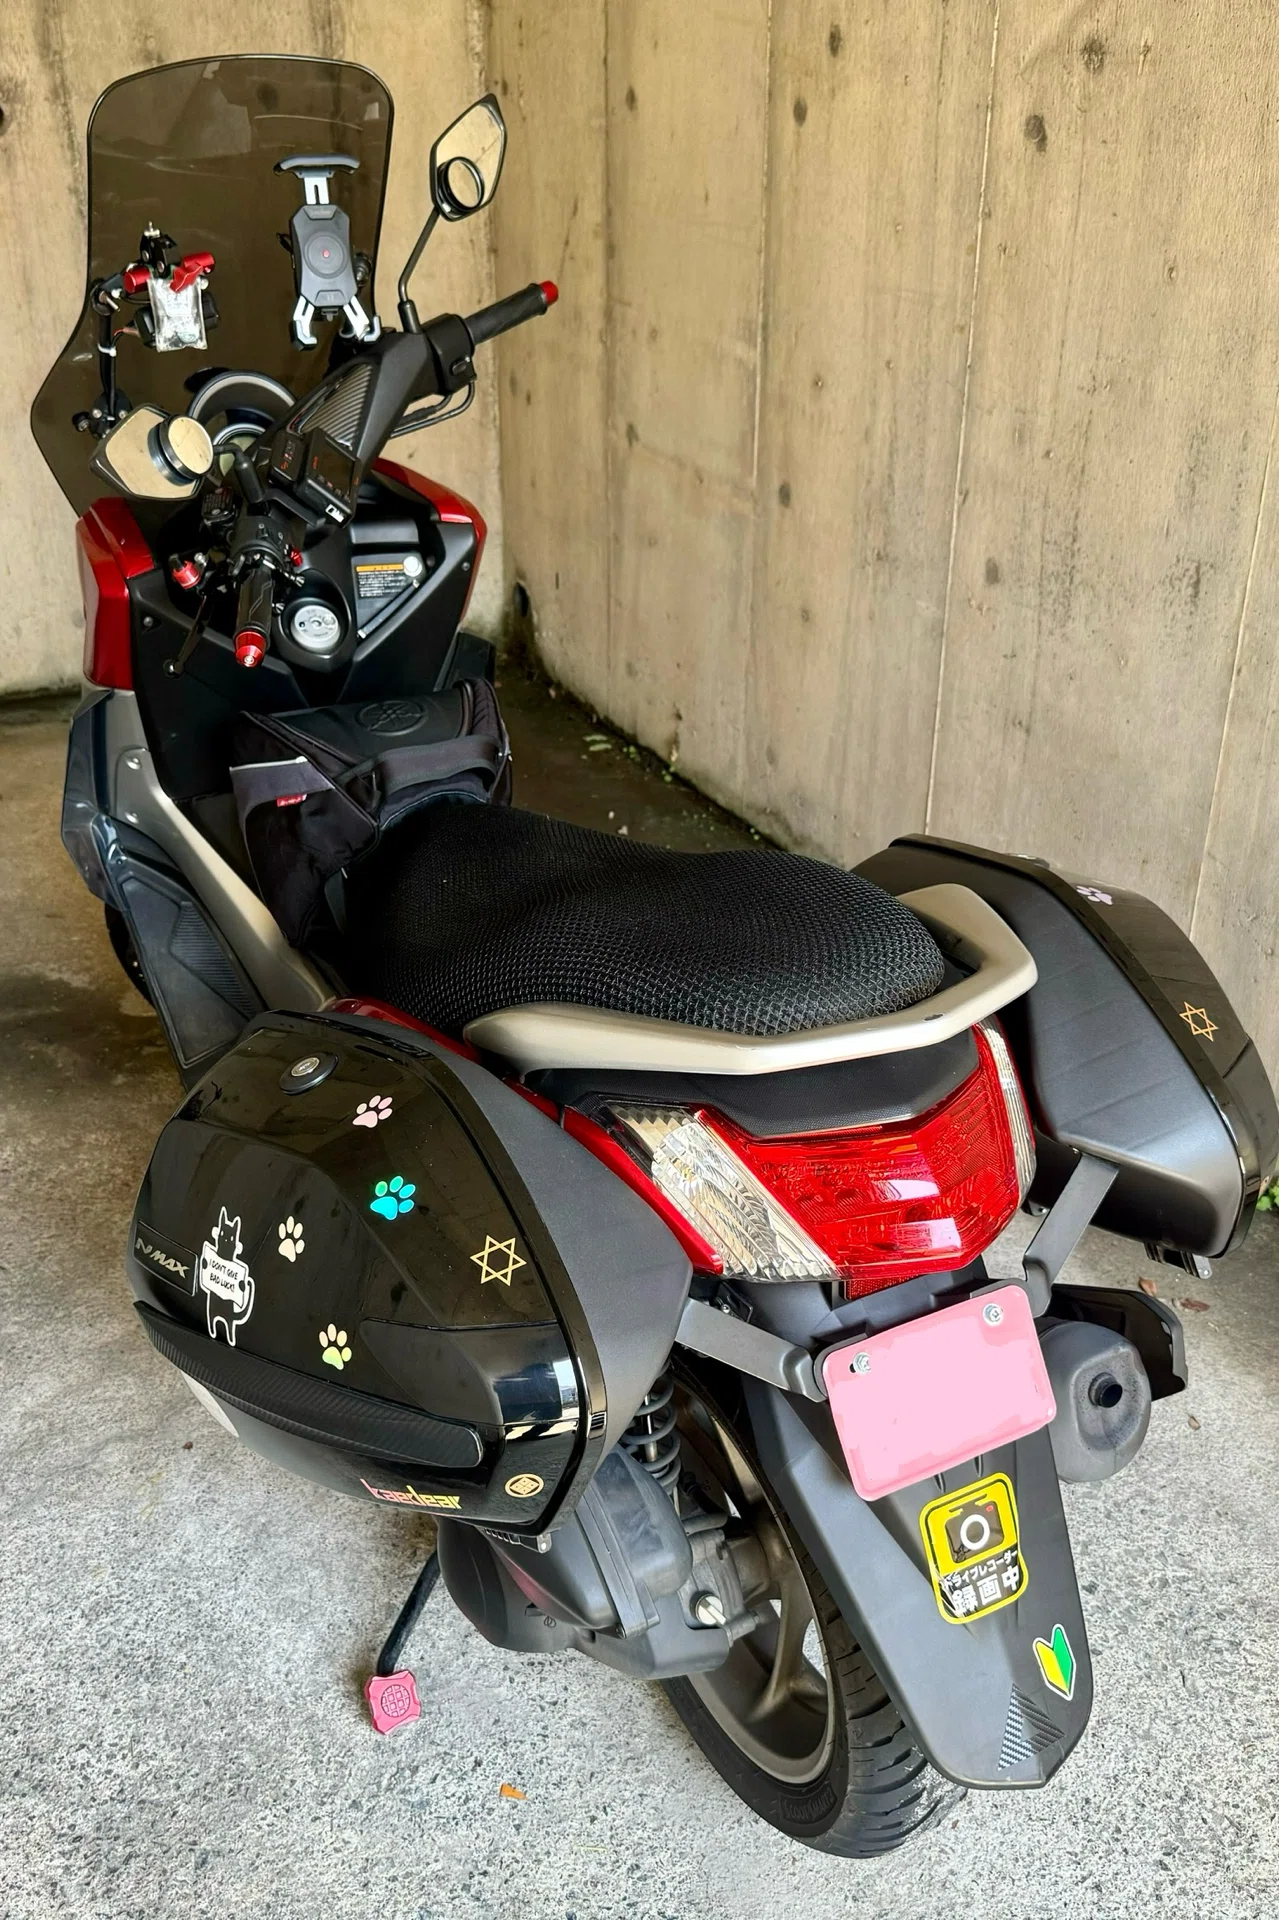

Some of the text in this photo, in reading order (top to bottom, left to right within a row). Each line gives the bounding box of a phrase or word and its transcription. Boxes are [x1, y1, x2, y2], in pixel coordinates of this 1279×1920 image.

[209, 1272, 220, 1284] BAD
[951, 1565, 1020, 1615] 録画中
